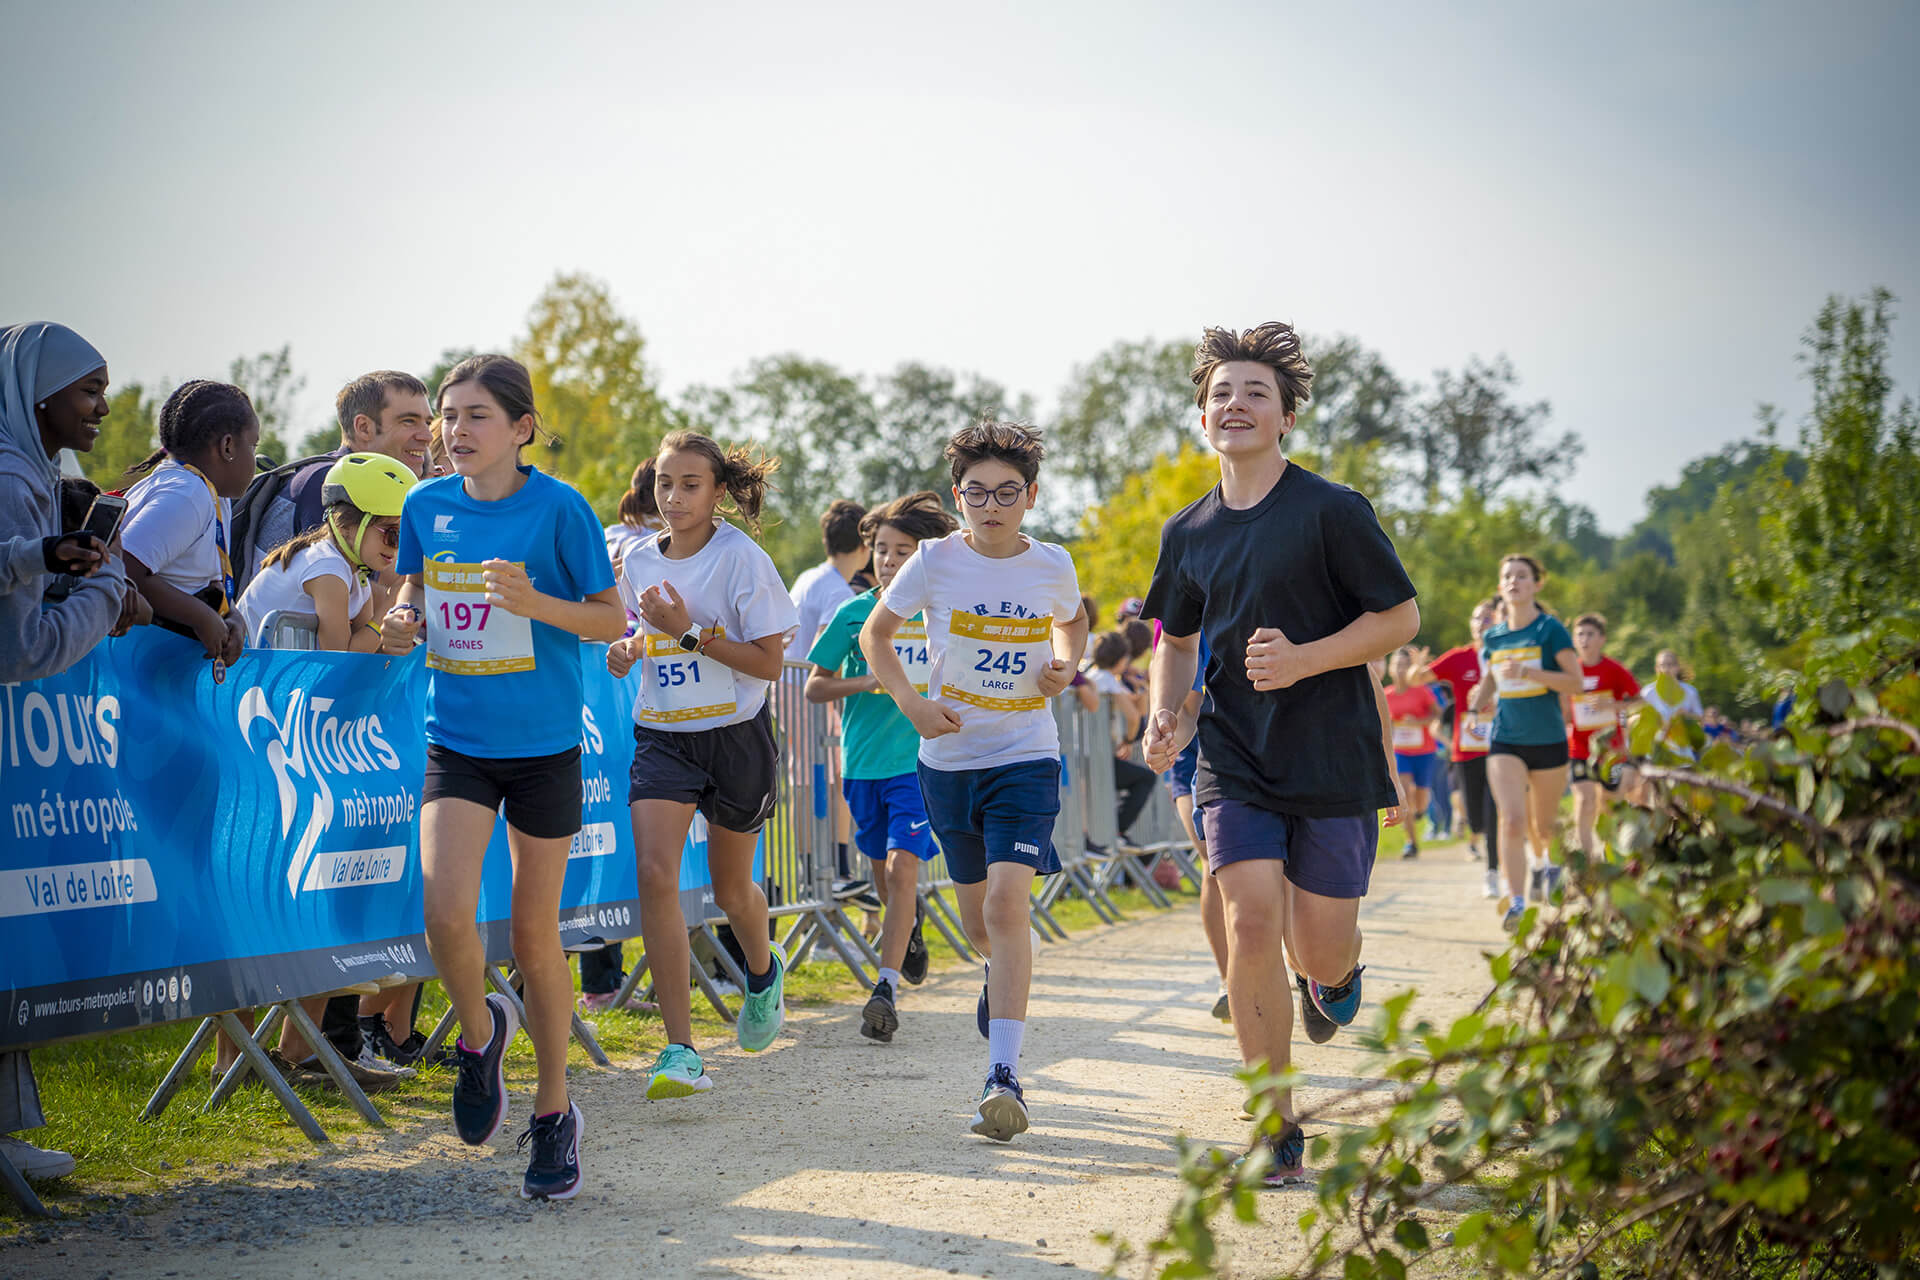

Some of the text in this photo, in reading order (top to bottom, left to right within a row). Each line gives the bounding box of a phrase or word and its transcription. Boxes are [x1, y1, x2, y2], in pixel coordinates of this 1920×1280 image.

[440, 601, 491, 631] 197
[448, 639, 484, 650] AGNES
[657, 660, 701, 688] 551
[974, 648, 1027, 675] 245
[981, 679, 1014, 691] LARGE
[0, 681, 121, 769] Tours
[310, 696, 401, 775] Tours
[12, 788, 138, 845] métropole
[342, 785, 415, 835] métropole
[582, 829, 604, 853] Loire
[1013, 841, 1040, 857] PUMA
[331, 853, 392, 884] Val de Loire
[25, 867, 134, 908] Val de Loire
[34, 985, 136, 1017] www.tours-metropole.fr
